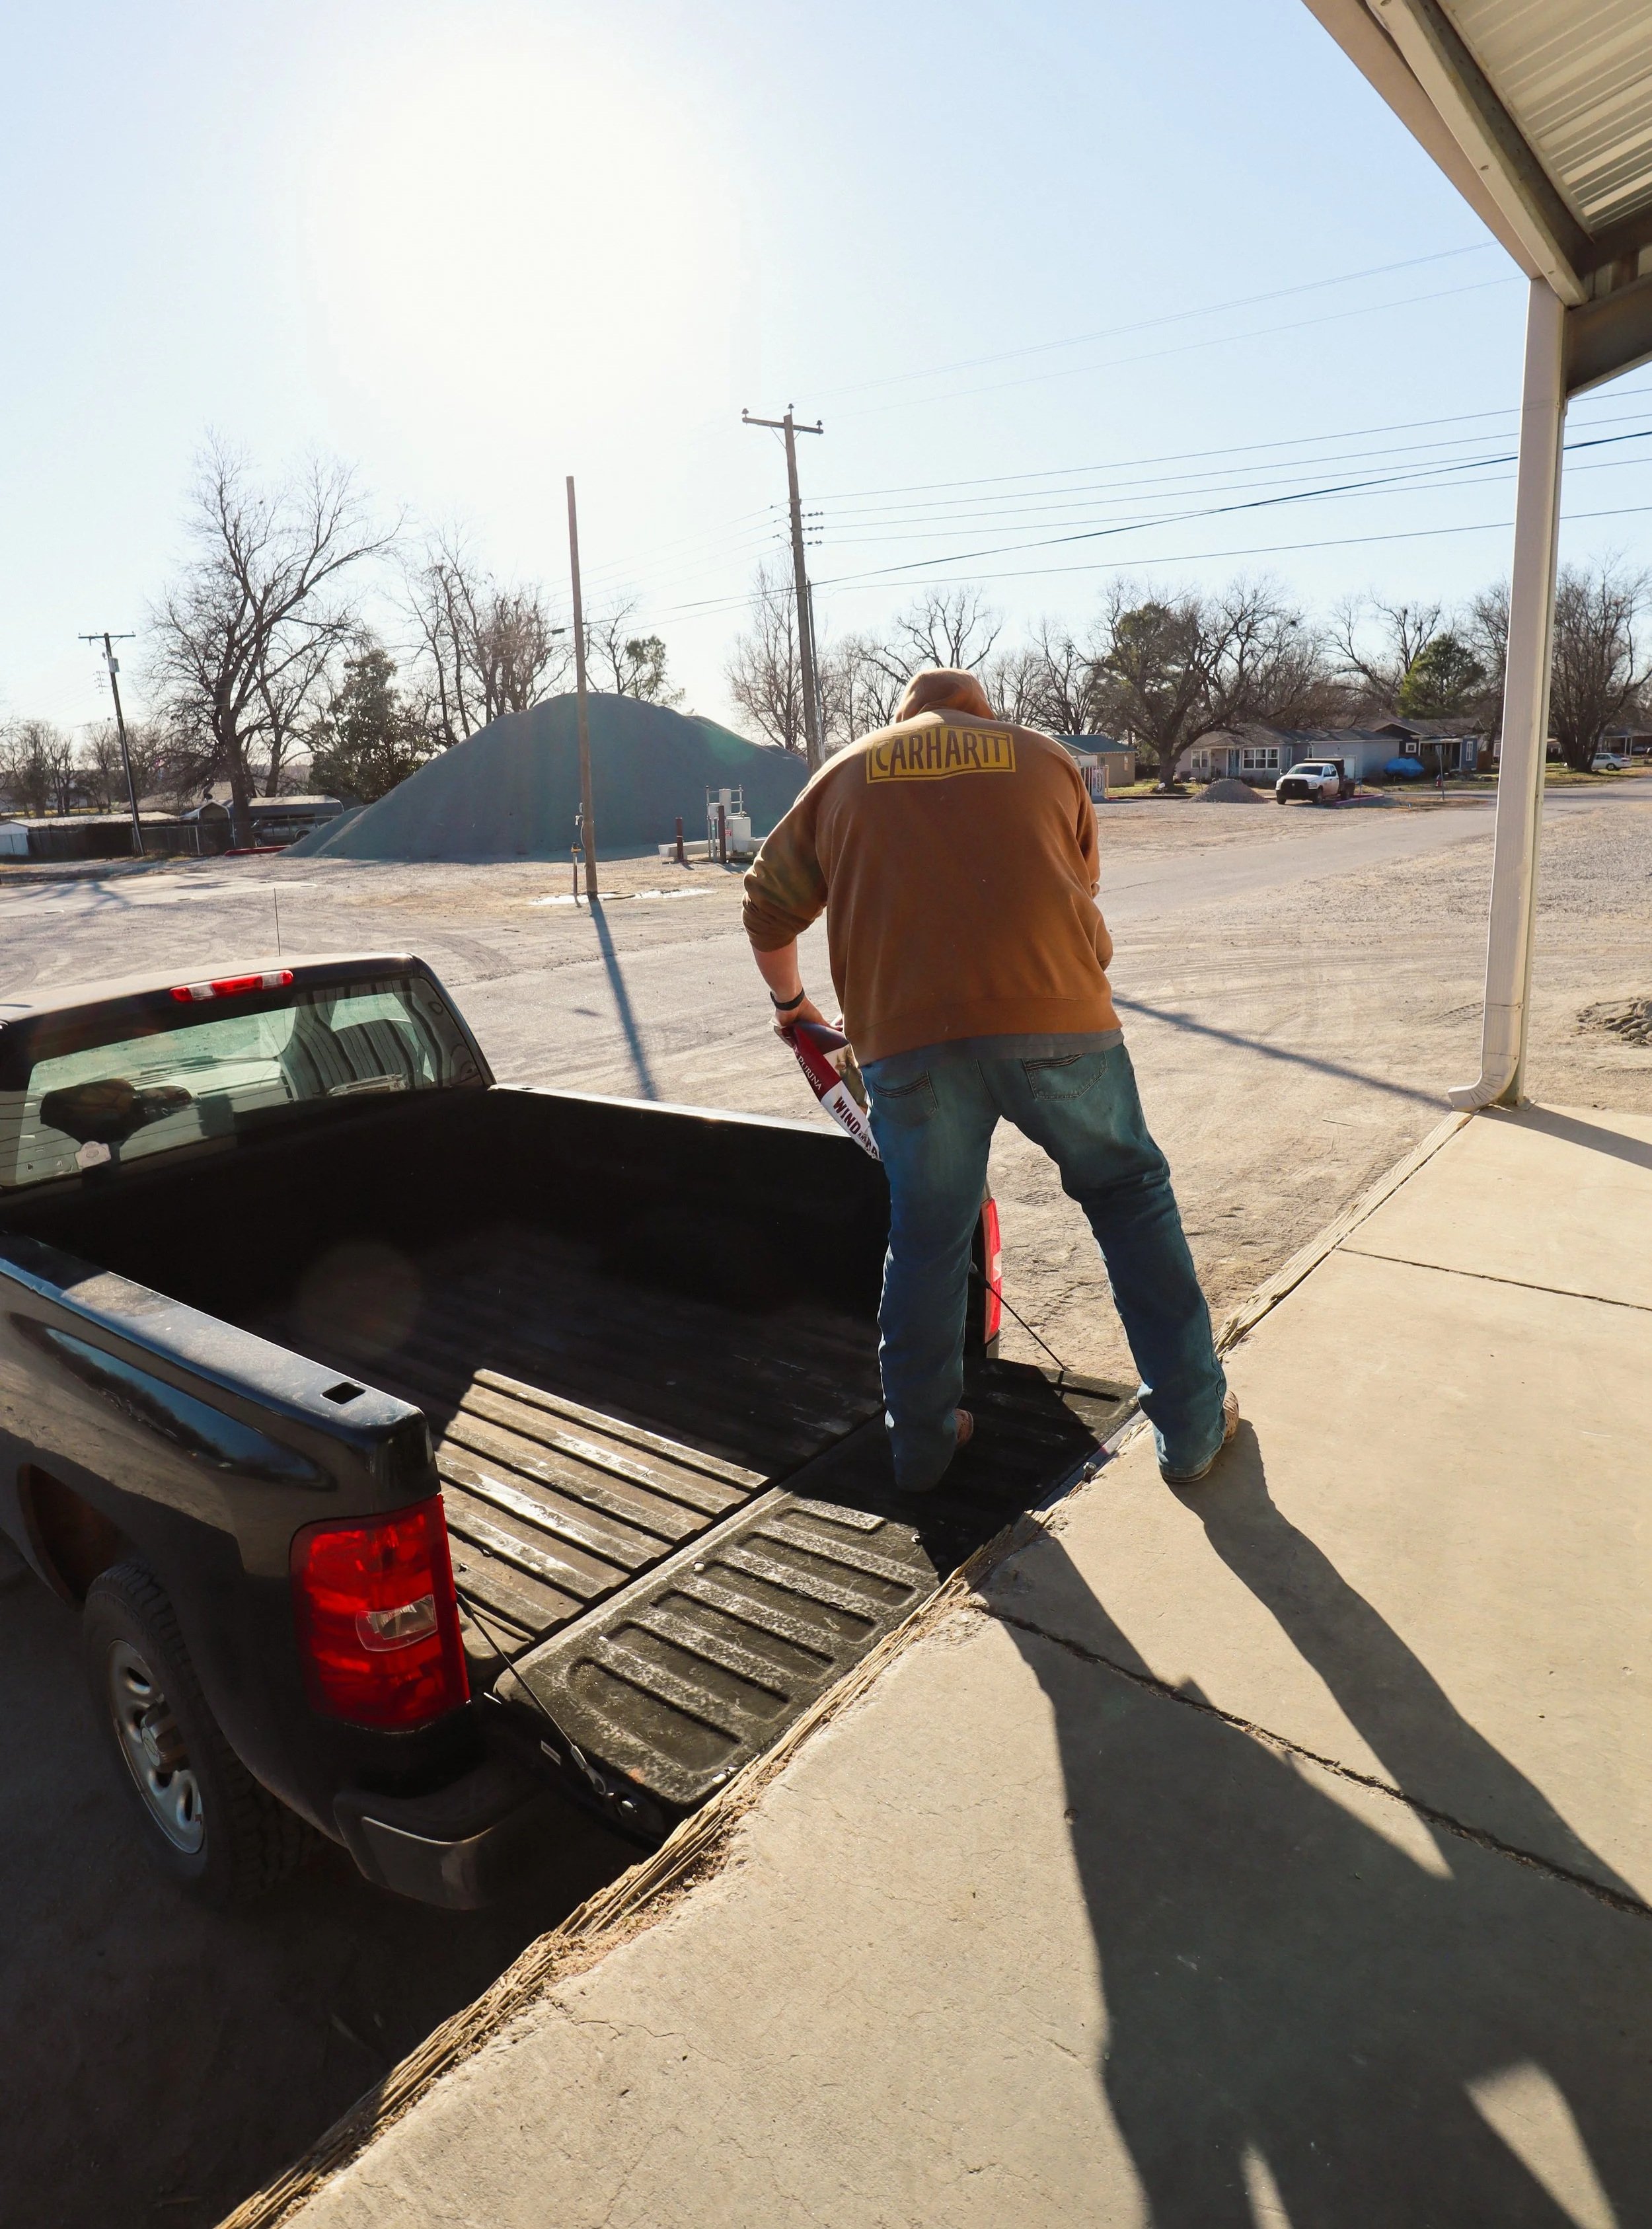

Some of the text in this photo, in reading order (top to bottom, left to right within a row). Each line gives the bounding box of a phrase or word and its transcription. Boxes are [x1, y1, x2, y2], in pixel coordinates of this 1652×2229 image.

[876, 728, 1007, 775] CARHARTT
[798, 1055, 822, 1090] PURINA
[833, 1096, 861, 1135] WIND
